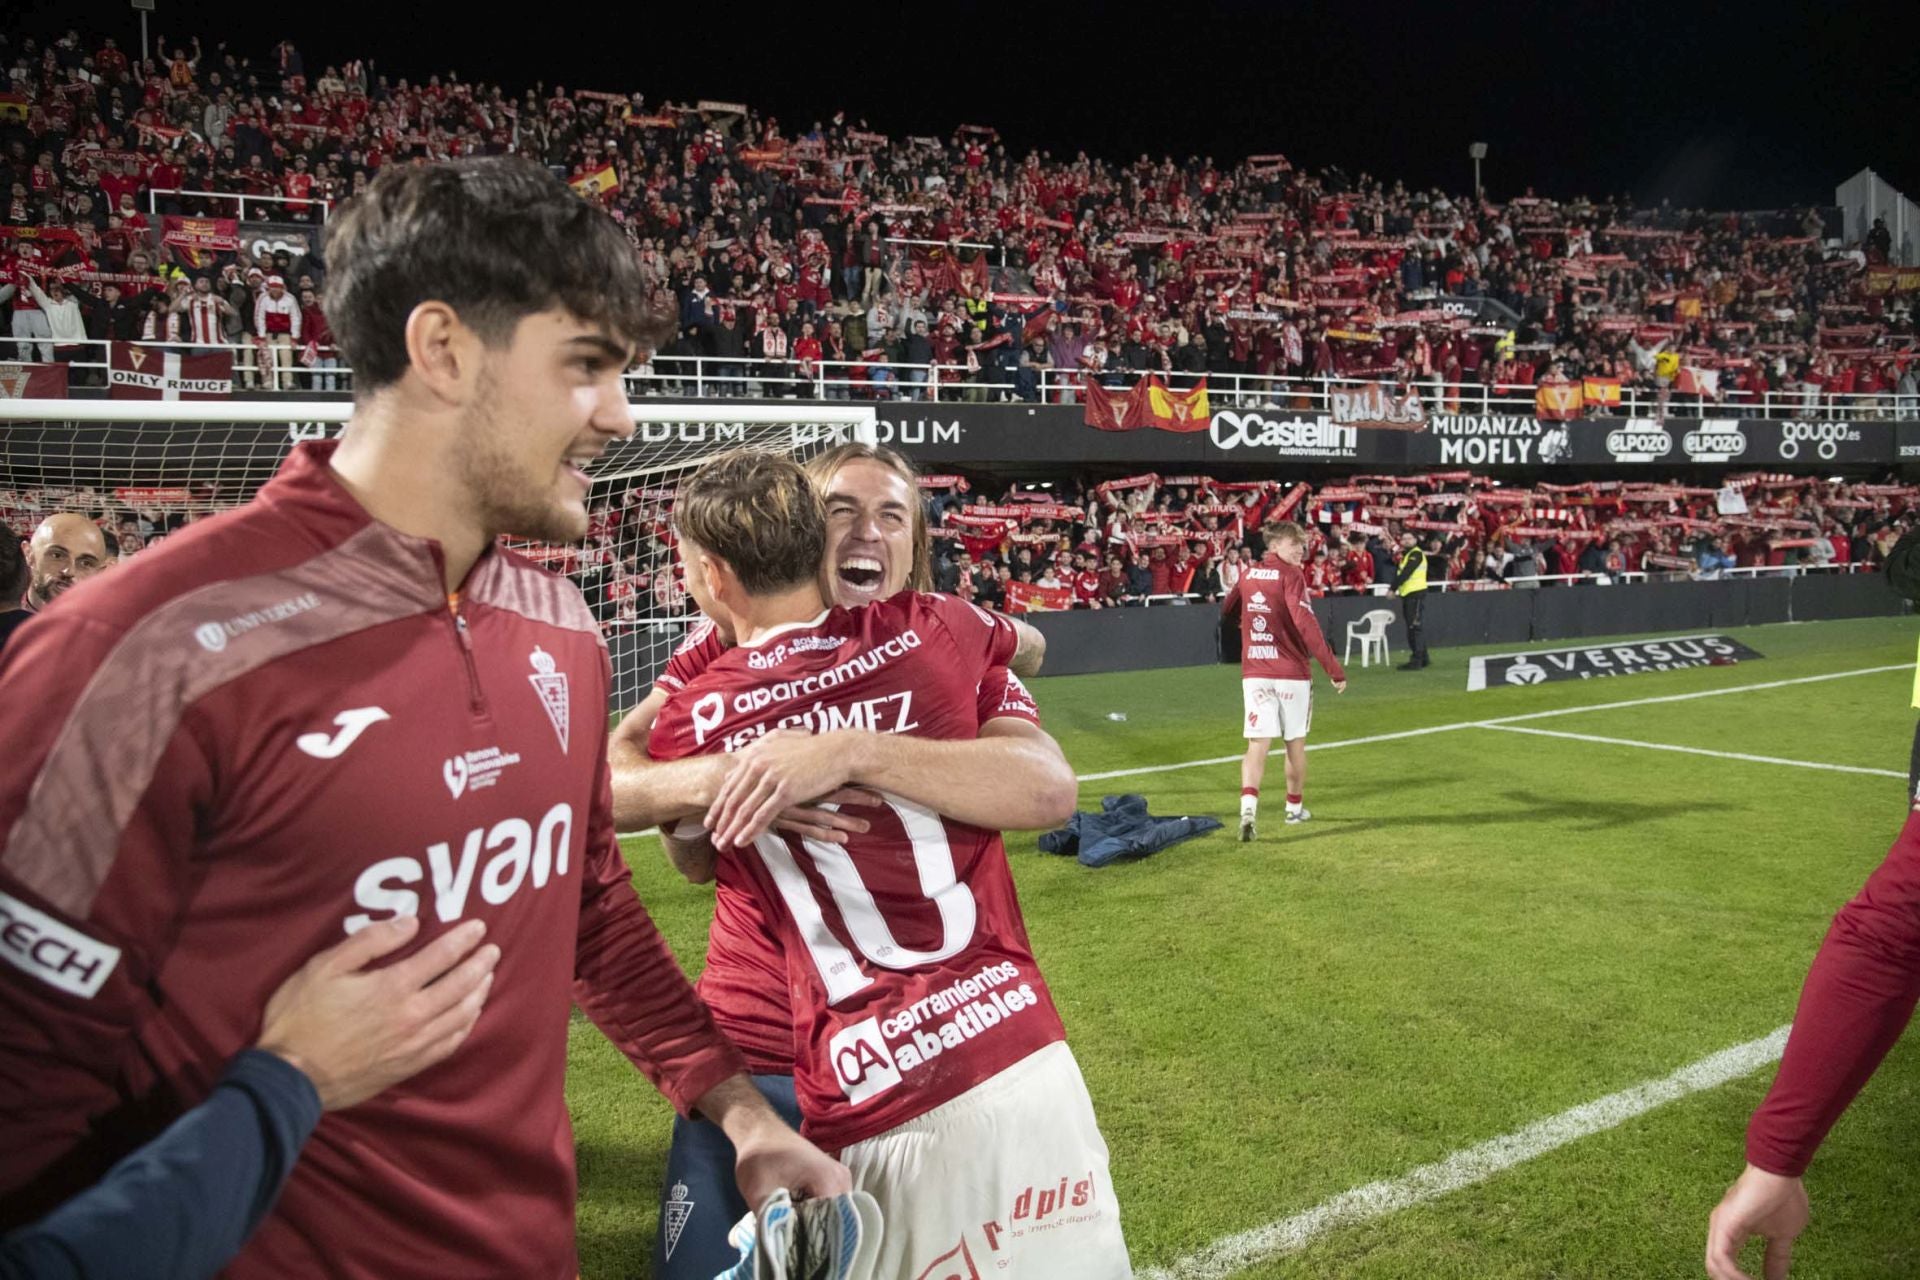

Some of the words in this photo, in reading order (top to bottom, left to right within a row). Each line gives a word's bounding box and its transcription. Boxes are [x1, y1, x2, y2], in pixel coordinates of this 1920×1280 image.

[113, 372, 160, 386] ONLY
[167, 379, 228, 391] RMUCF
[1241, 413, 1358, 448] Castellini
[1433, 416, 1542, 436] MUDANZAS
[1440, 438, 1531, 464] MOFLY
[733, 629, 921, 714] aparcamurcia
[1546, 638, 1735, 671] VERSUS
[343, 803, 572, 935] svan
[881, 961, 1020, 1039] cerramientos
[895, 983, 1038, 1071] abatibles
